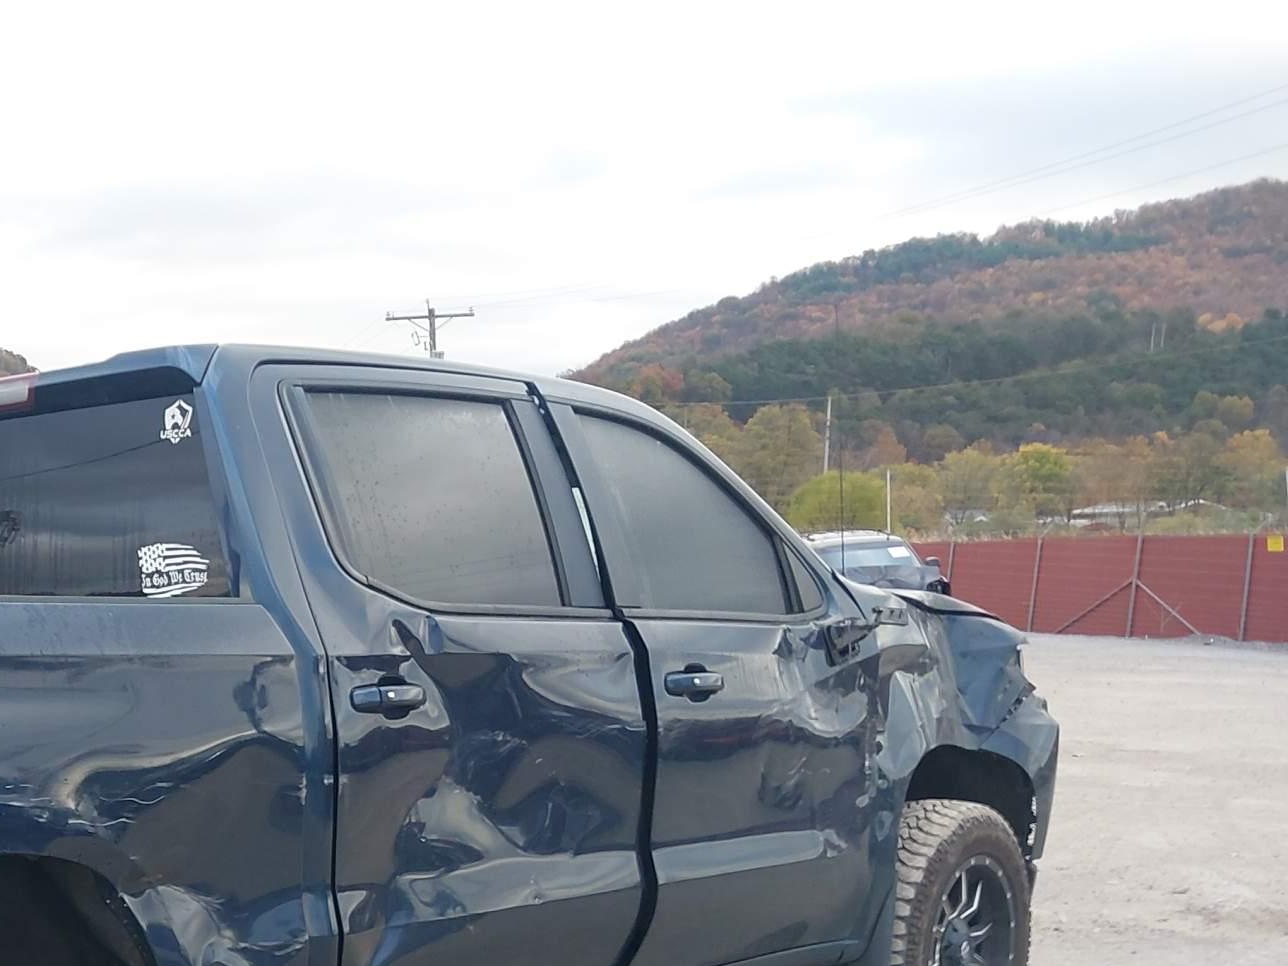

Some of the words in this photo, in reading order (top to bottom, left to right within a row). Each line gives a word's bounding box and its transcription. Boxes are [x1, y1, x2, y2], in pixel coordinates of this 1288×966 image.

[160, 428, 191, 439] USCCA
[141, 573, 152, 587] In
[152, 573, 169, 587] God
[169, 570, 183, 584] We
[183, 569, 208, 583] Trust
